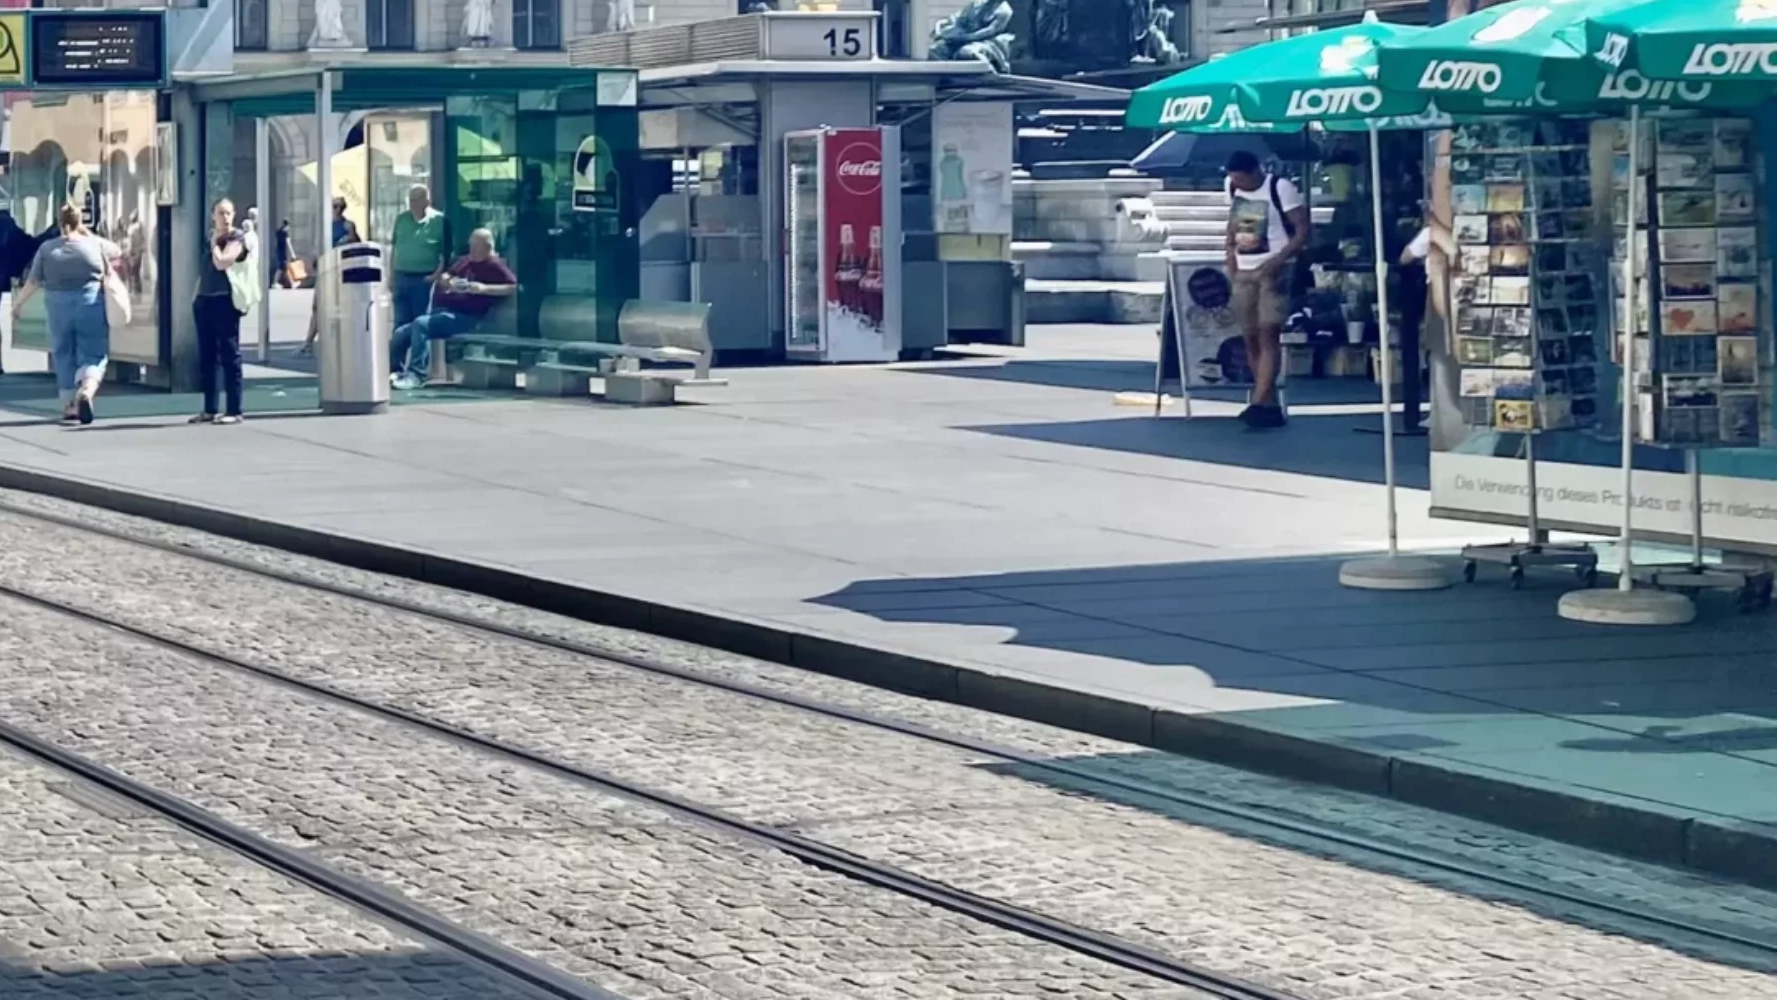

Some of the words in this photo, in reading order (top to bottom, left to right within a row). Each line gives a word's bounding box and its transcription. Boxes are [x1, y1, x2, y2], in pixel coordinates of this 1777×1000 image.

[823, 28, 861, 56] 15
[1418, 60, 1502, 93] LOTTO
[1158, 95, 1213, 123] LOTTO
[1284, 85, 1383, 117] LOTTO
[1476, 478, 1554, 503] Verwendng
